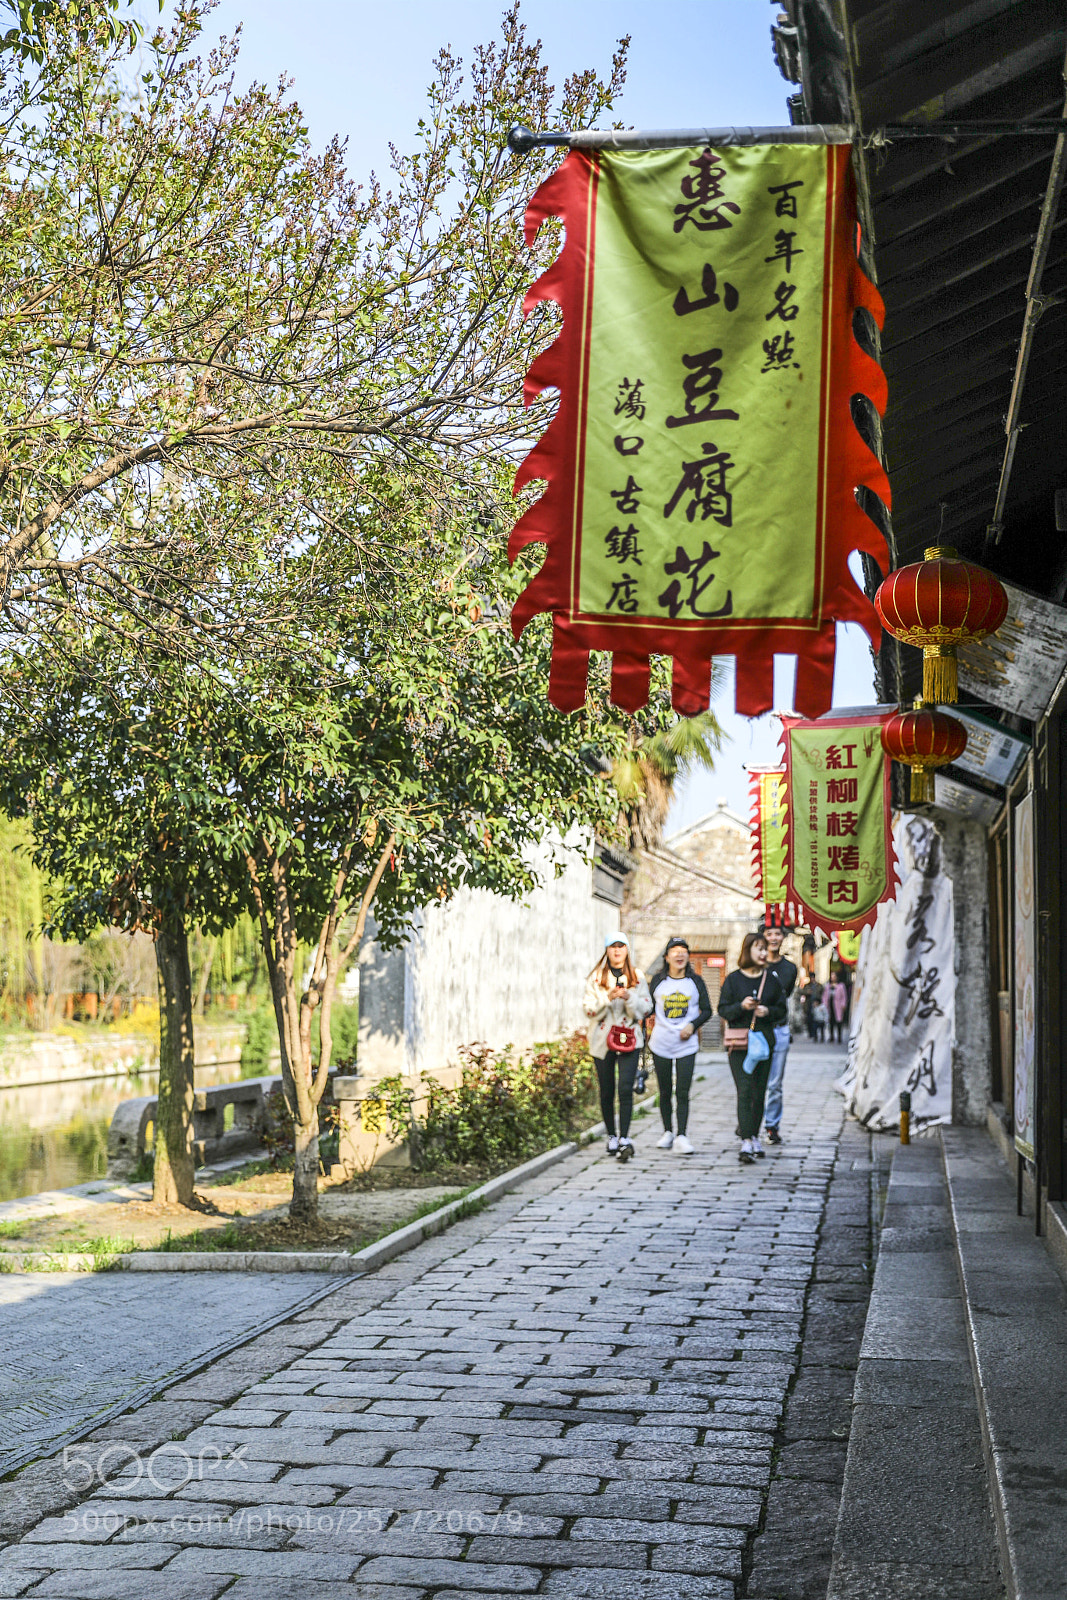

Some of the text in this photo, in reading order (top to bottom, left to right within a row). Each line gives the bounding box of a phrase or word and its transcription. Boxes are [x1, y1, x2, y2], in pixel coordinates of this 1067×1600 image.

[761, 181, 804, 373] 百年名點
[658, 148, 740, 619] 惠山豆腐花
[826, 744, 859, 904] 紅柳枝烤肉
